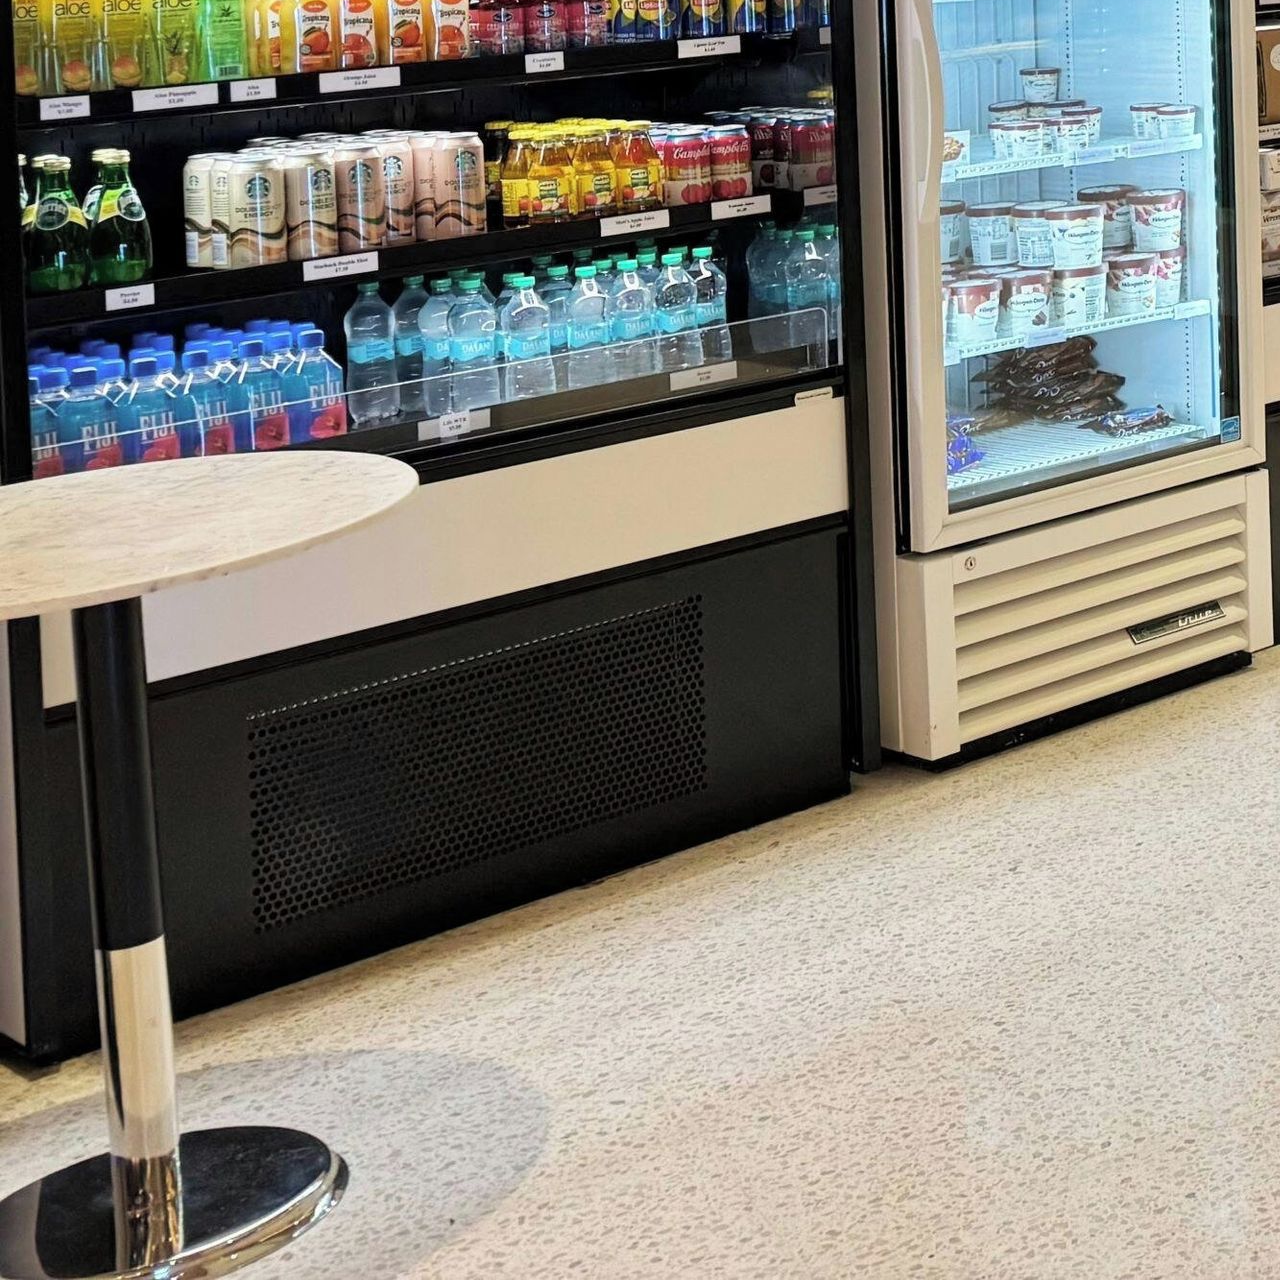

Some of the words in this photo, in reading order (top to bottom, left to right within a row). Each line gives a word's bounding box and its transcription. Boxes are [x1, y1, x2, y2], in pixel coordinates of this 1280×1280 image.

[55, 0, 90, 17] aloe
[309, 380, 343, 410] FIJI
[82, 420, 119, 452] FIJI
[140, 410, 176, 442] FIJI
